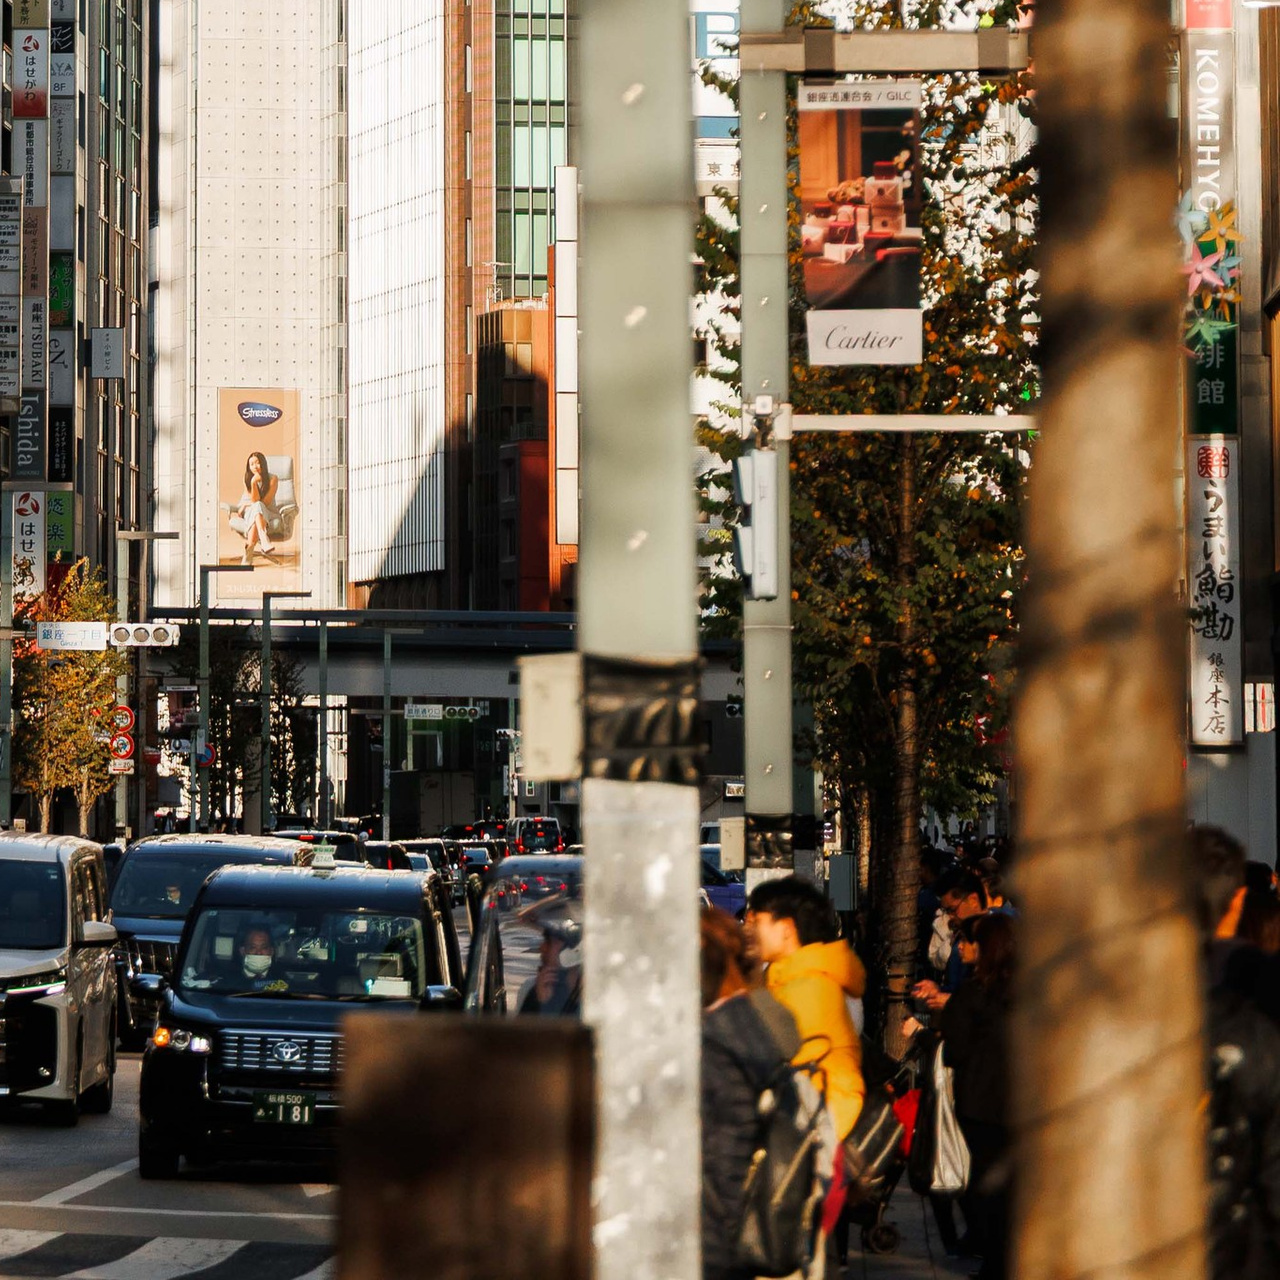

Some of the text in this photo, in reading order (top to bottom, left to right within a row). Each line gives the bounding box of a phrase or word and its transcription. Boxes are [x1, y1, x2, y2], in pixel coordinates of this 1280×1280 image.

[24, 56, 36, 101] はせがわ
[53, 82, 66, 92] 8F
[886, 91, 911, 102] GILC
[824, 324, 903, 351] Cartier
[242, 407, 279, 419] Stressless
[18, 395, 39, 466] Ishida
[1195, 480, 1234, 641] うまい鮨勘
[42, 629, 101, 640] 銀座一丁目
[1202, 652, 1229, 735] 銀座本店
